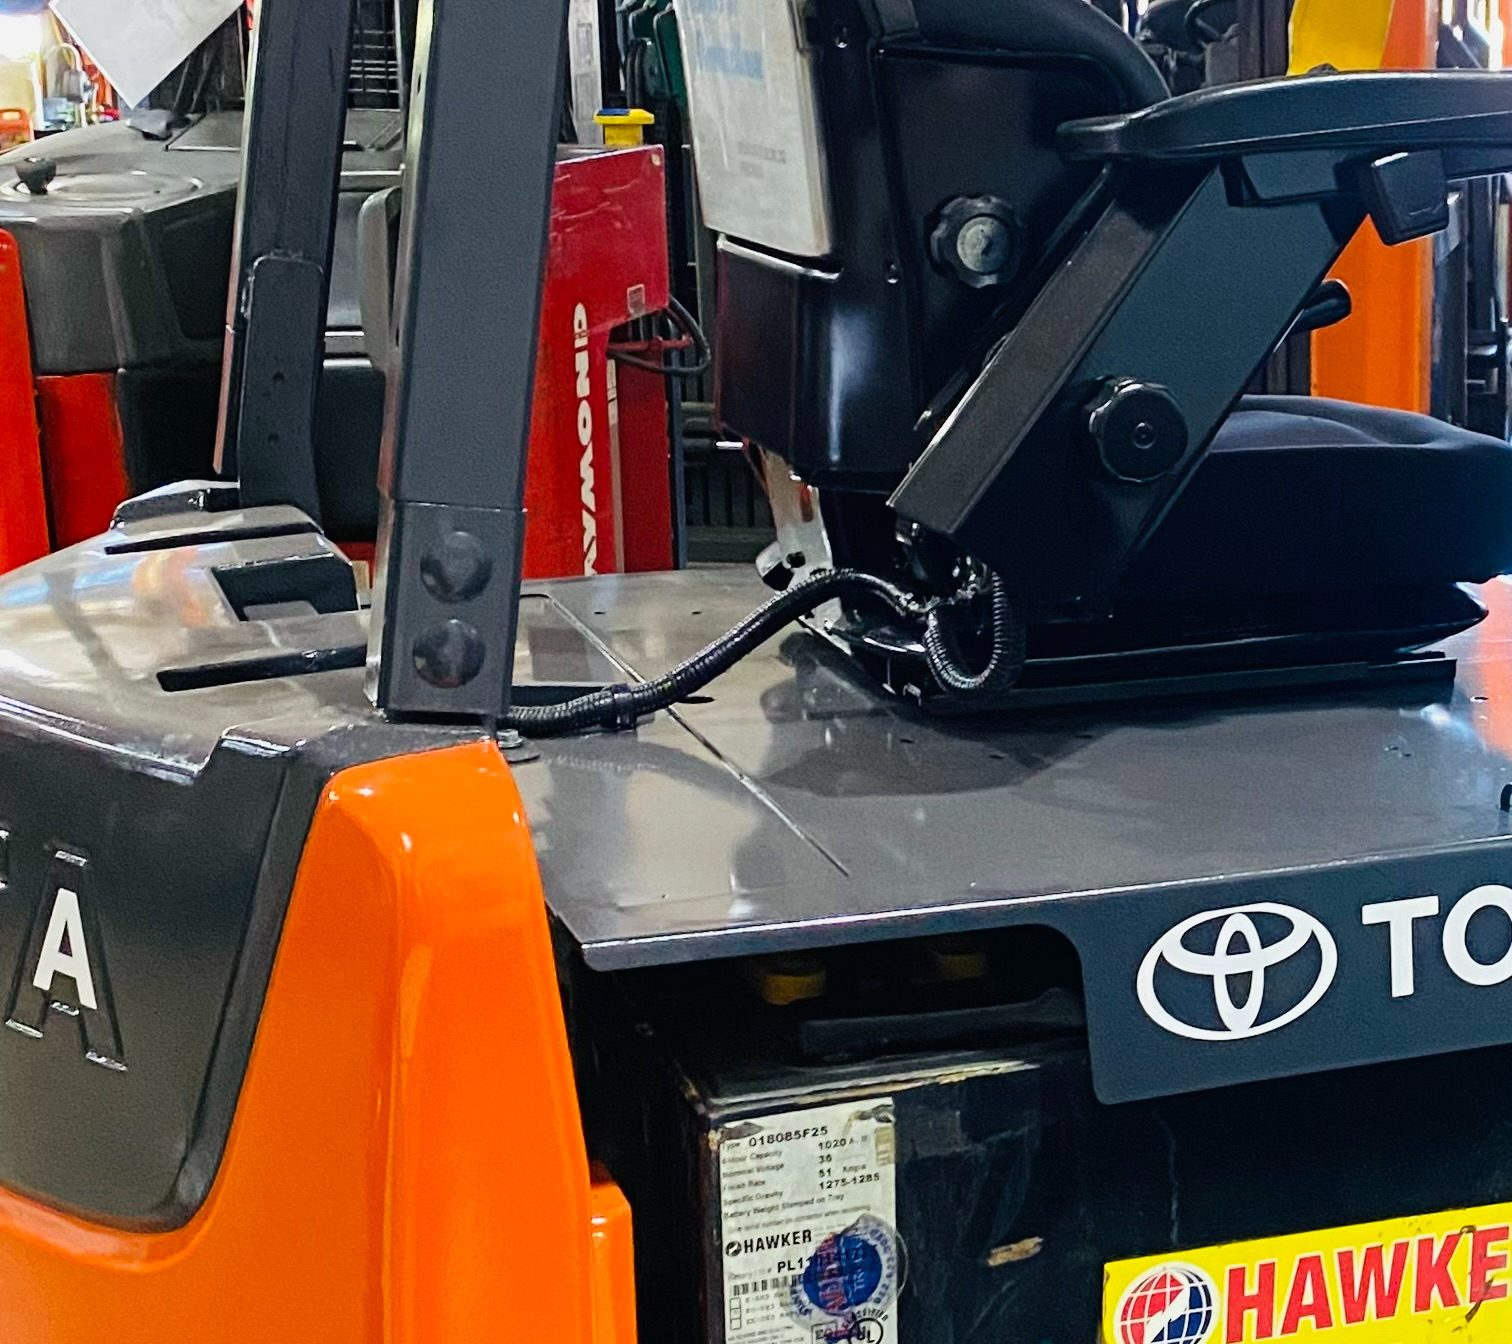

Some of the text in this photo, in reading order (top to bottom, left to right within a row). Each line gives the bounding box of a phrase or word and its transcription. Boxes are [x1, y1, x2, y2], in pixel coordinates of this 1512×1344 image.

[748, 1125, 829, 1148] 018085F25
[817, 1137, 847, 1150] 1020
[743, 1228, 813, 1254] HAWKER
